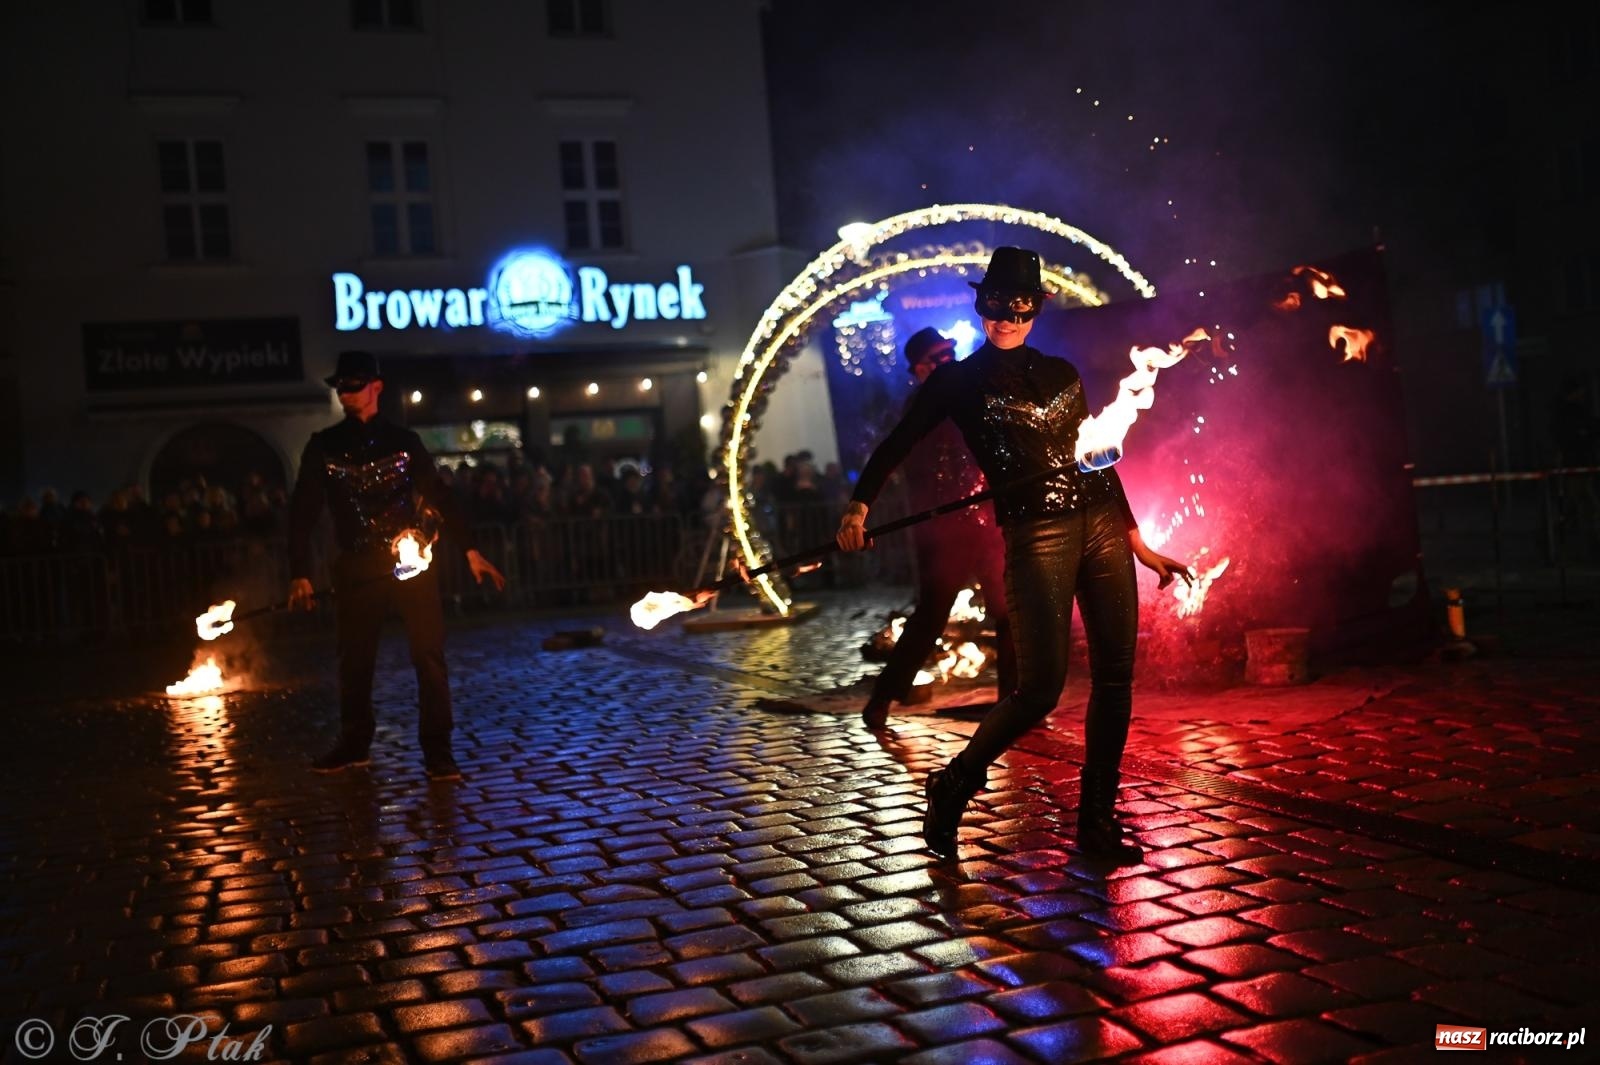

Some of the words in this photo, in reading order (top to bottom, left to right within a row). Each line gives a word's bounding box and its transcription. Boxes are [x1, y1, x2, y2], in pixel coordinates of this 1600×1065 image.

[333, 272, 486, 331] Browar
[578, 265, 707, 329] Rynek
[175, 340, 289, 376] Wypieki
